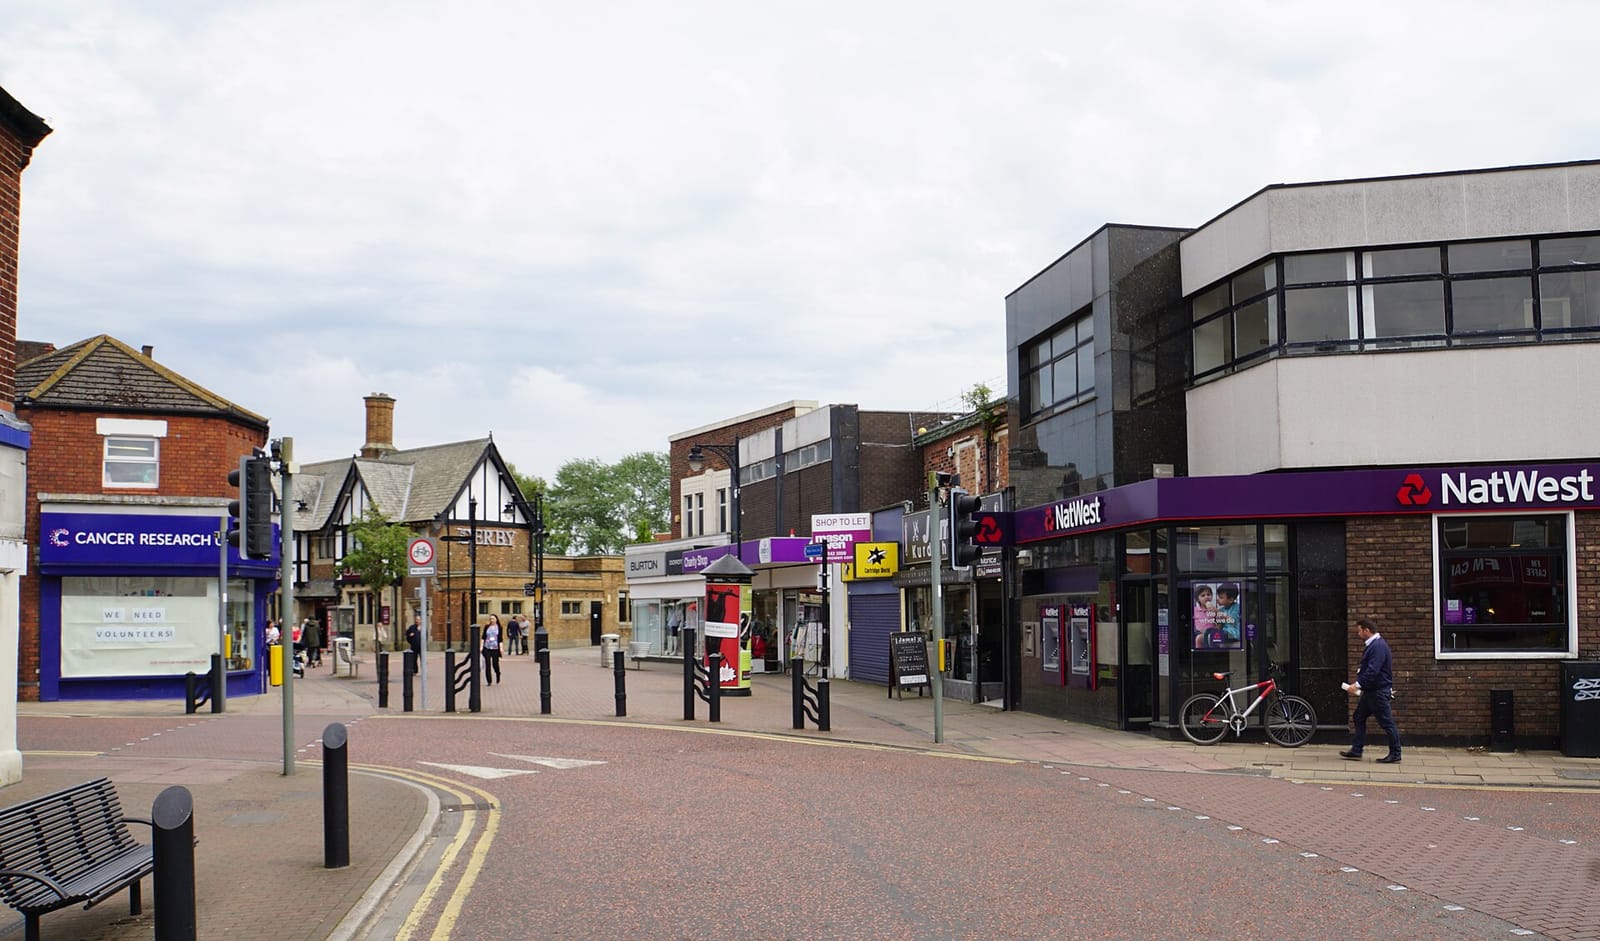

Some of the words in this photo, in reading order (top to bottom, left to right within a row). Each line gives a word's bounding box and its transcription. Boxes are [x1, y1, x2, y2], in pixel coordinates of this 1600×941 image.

[1441, 468, 1594, 504] NatWest
[1055, 496, 1101, 530] NatWest
[815, 518, 838, 527] SHOP
[840, 518, 850, 526] TO
[852, 517, 867, 526] LET
[75, 532, 135, 544] CANCER
[140, 533, 211, 546] RESEARCH
[815, 533, 853, 543] mason
[630, 559, 658, 571] BURTON
[683, 556, 698, 569] Charity
[698, 555, 709, 567] Shop
[864, 567, 880, 575] Cartridge
[104, 611, 120, 619] WE
[133, 611, 162, 619] NEED
[96, 630, 174, 639] VOLUNTEERS!
